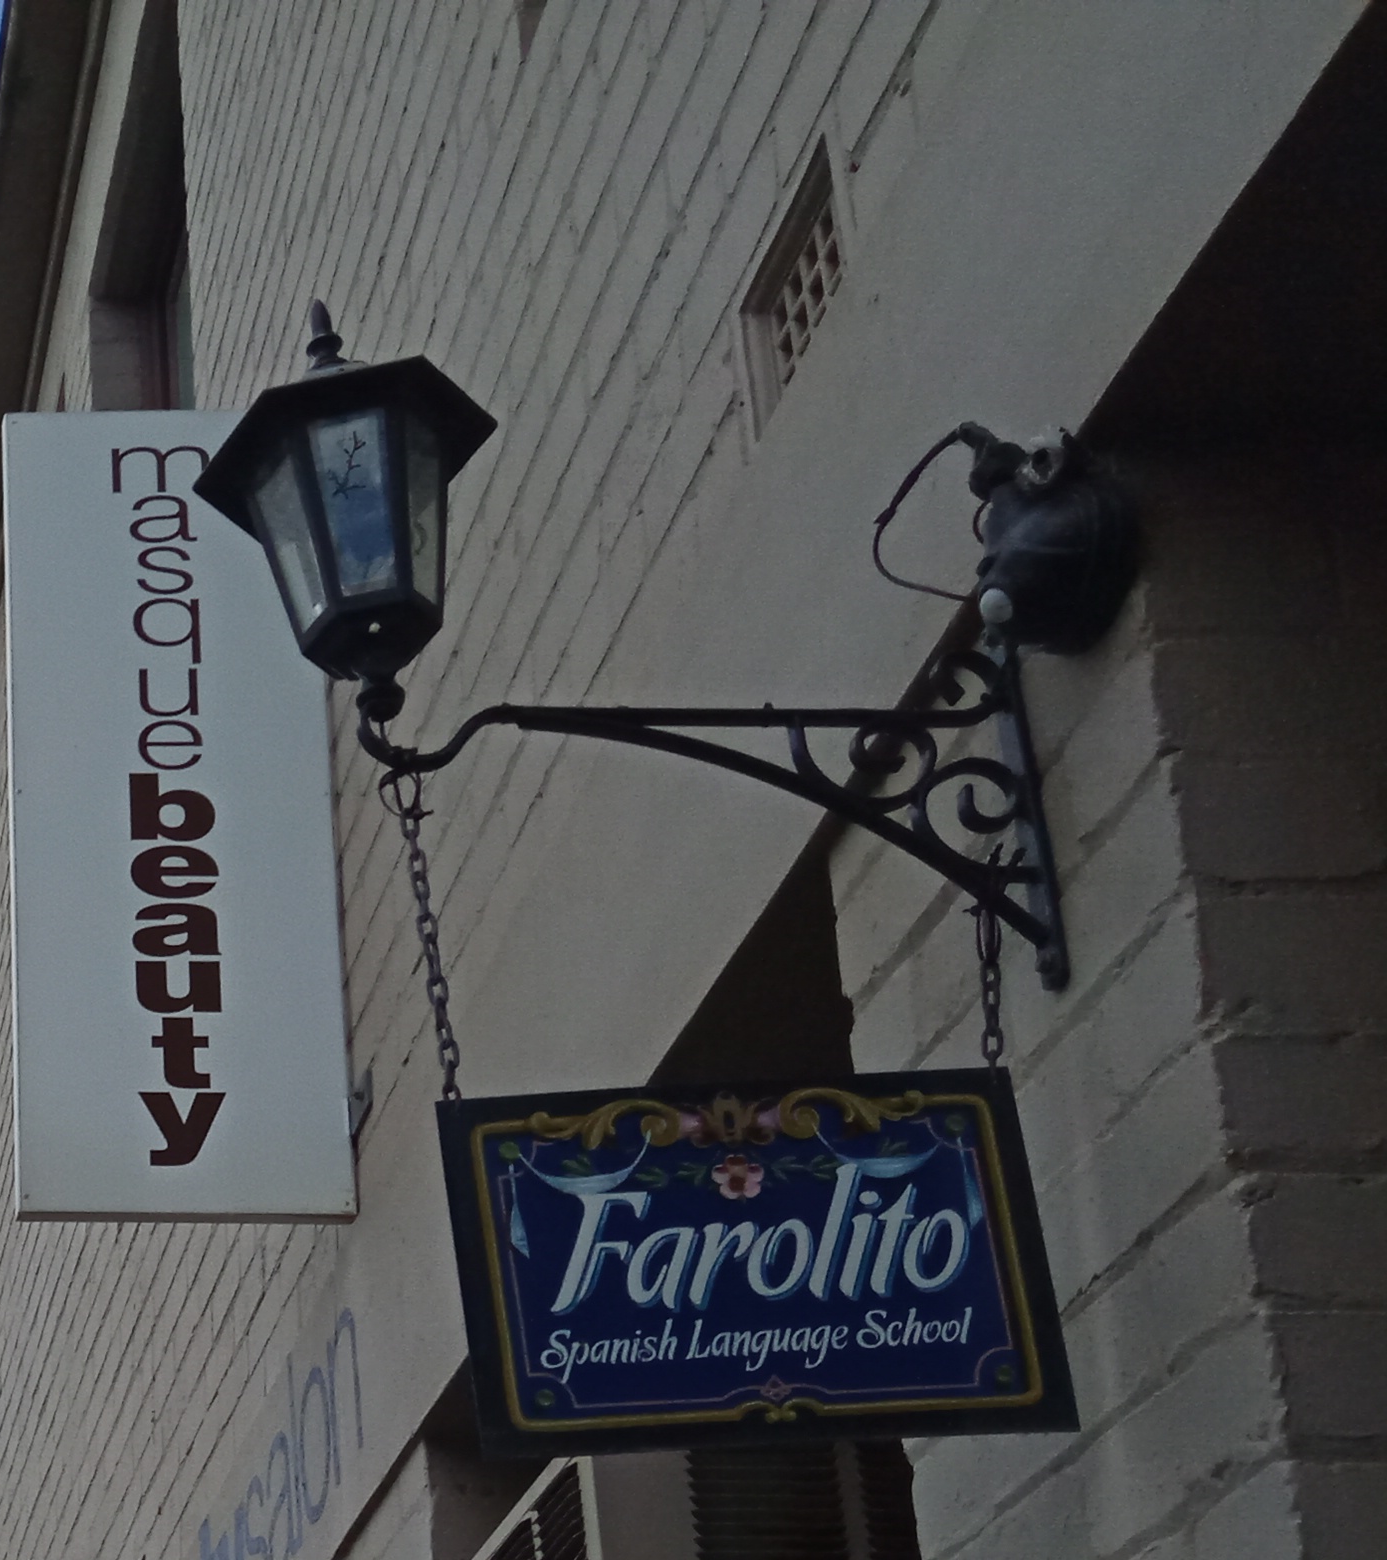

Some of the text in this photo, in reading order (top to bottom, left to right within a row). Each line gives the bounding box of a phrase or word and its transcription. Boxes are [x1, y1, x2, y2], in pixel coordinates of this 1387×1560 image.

[111, 444, 227, 1167] masque beauty
[550, 1163, 969, 1313] Farolito
[540, 1306, 973, 1384] Spanish Language School
